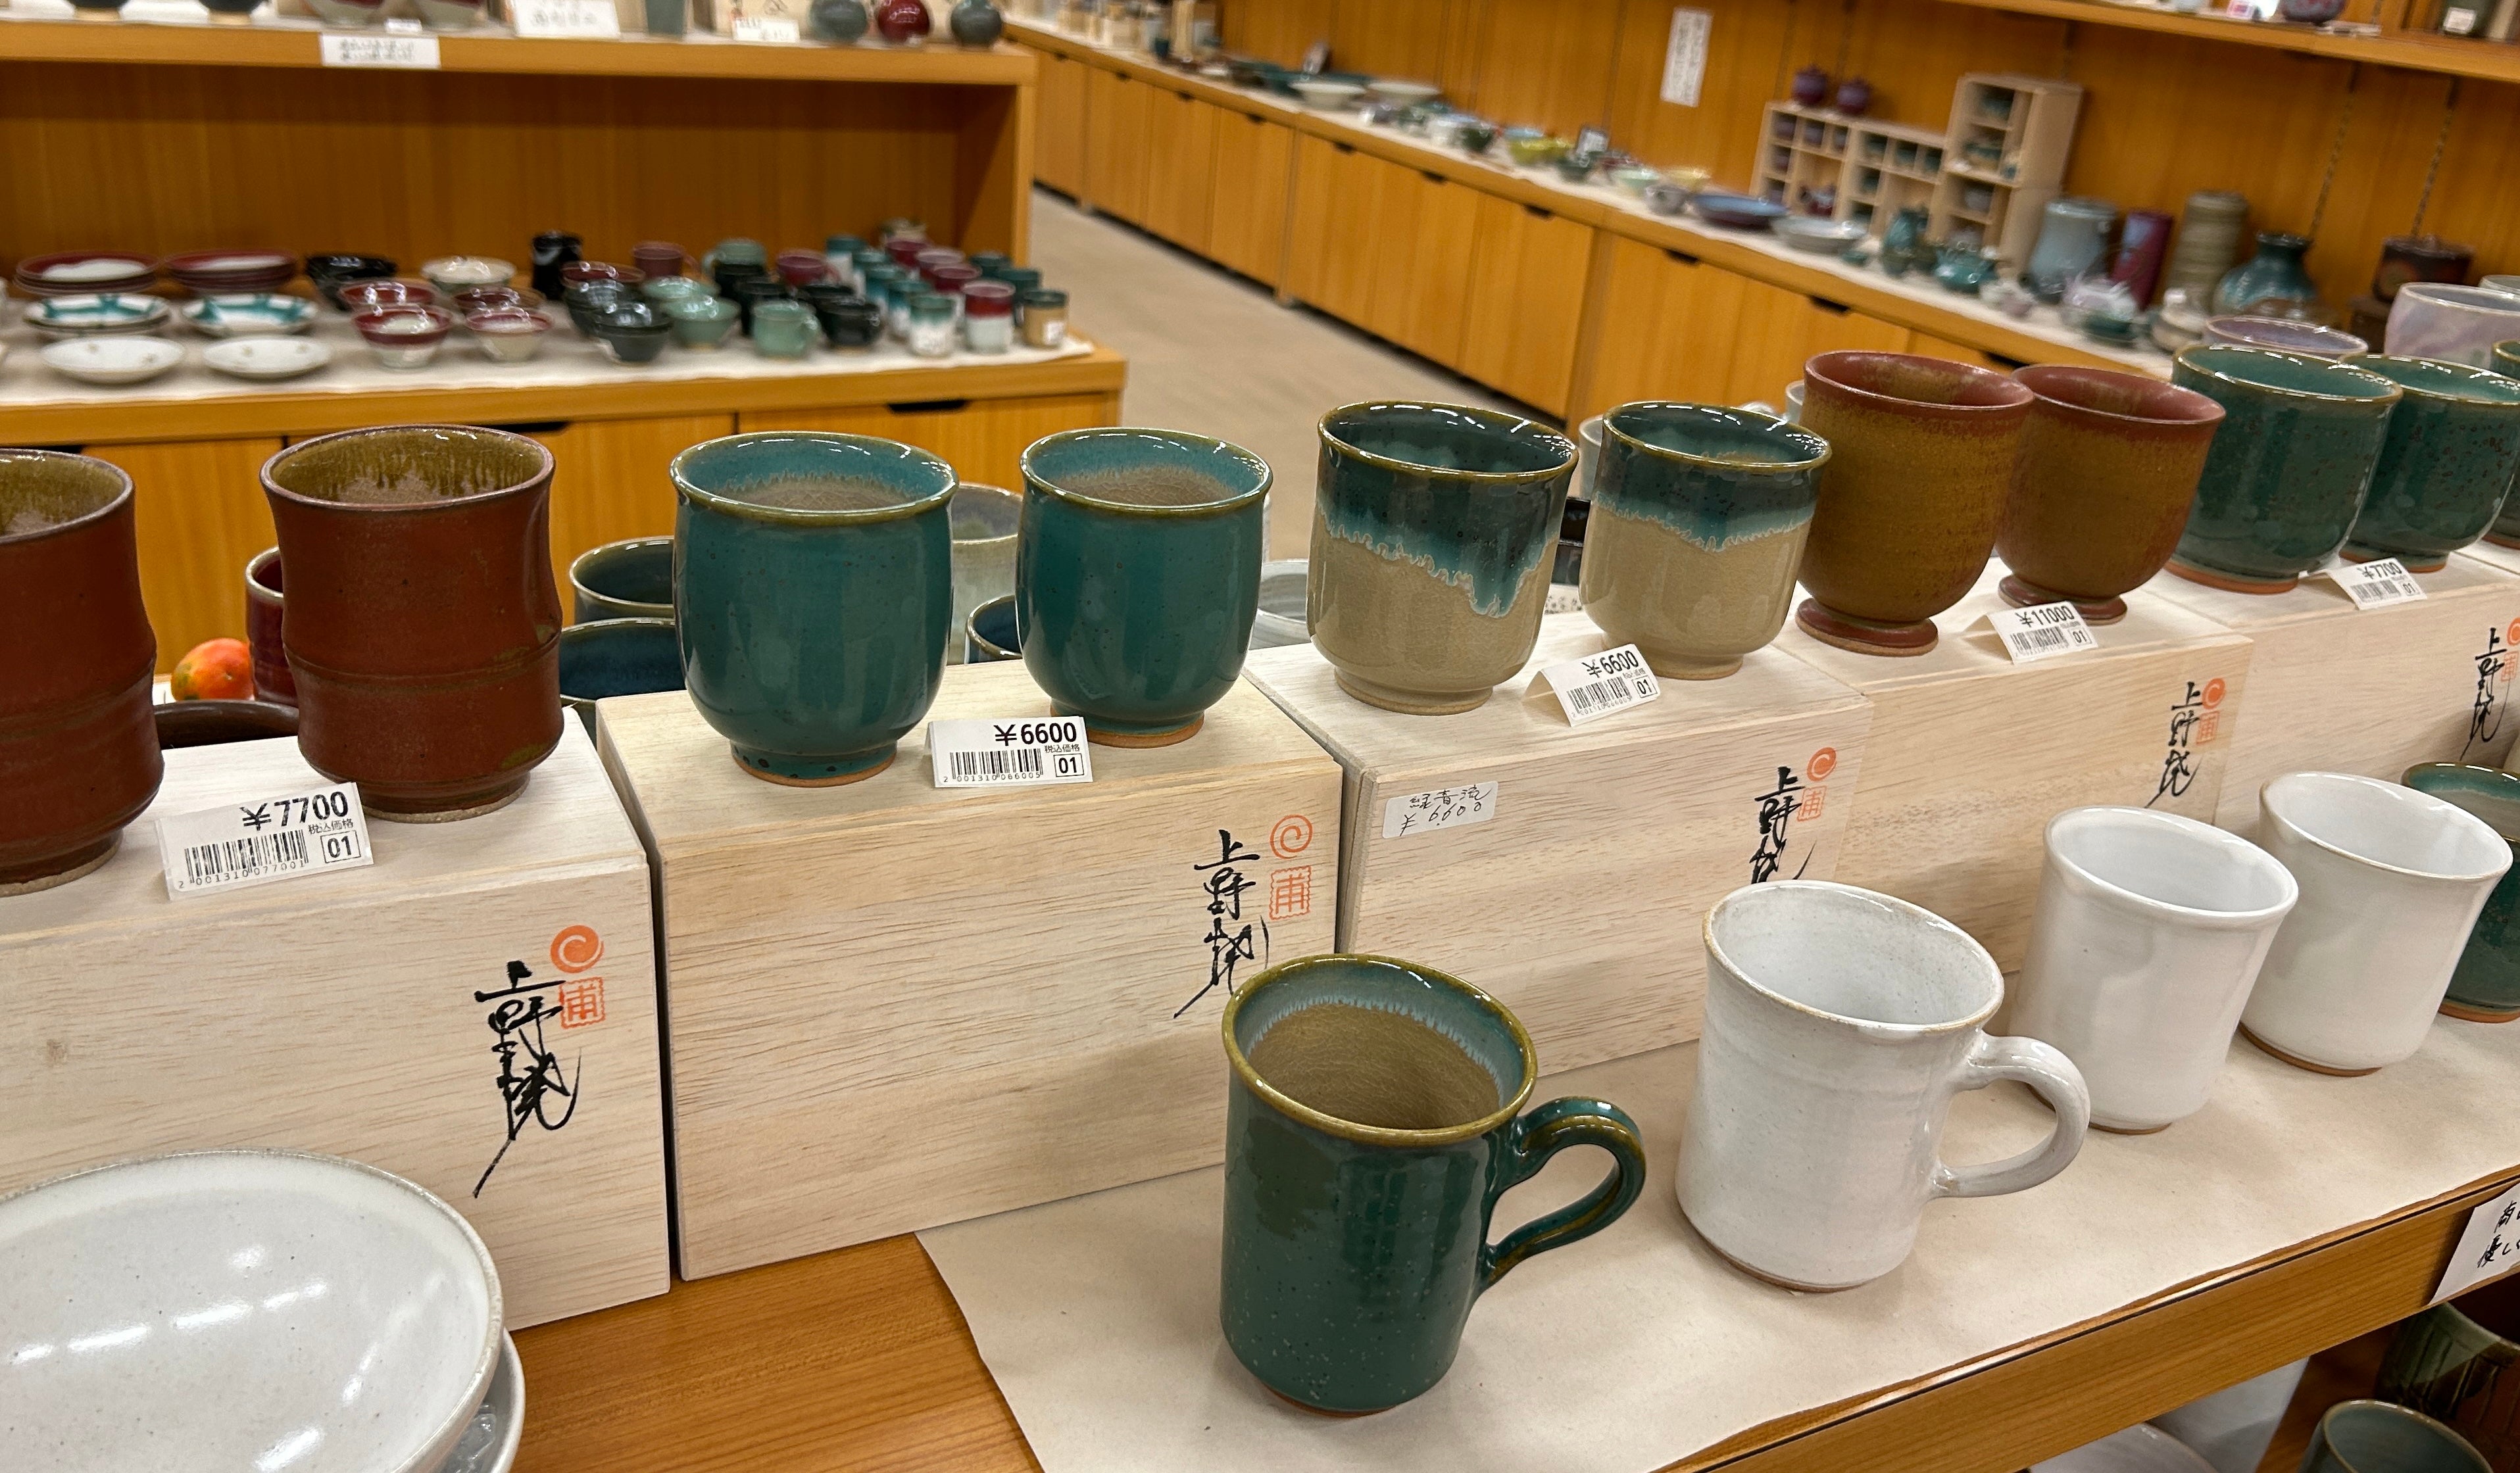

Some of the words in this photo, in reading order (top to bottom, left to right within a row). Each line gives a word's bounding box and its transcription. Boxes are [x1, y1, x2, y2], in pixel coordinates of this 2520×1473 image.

[2356, 562, 2402, 579] ¥7700
[2402, 582, 2416, 594] 01
[2015, 605, 2075, 627] ¥11000
[2073, 629, 2088, 644] 01
[1581, 650, 1639, 679] ¥6600
[1636, 679, 1652, 695] 01
[993, 721, 1077, 746] ¥6600
[1058, 756, 1077, 774] 01
[239, 790, 349, 831] ¥7700
[327, 834, 353, 858] 01
